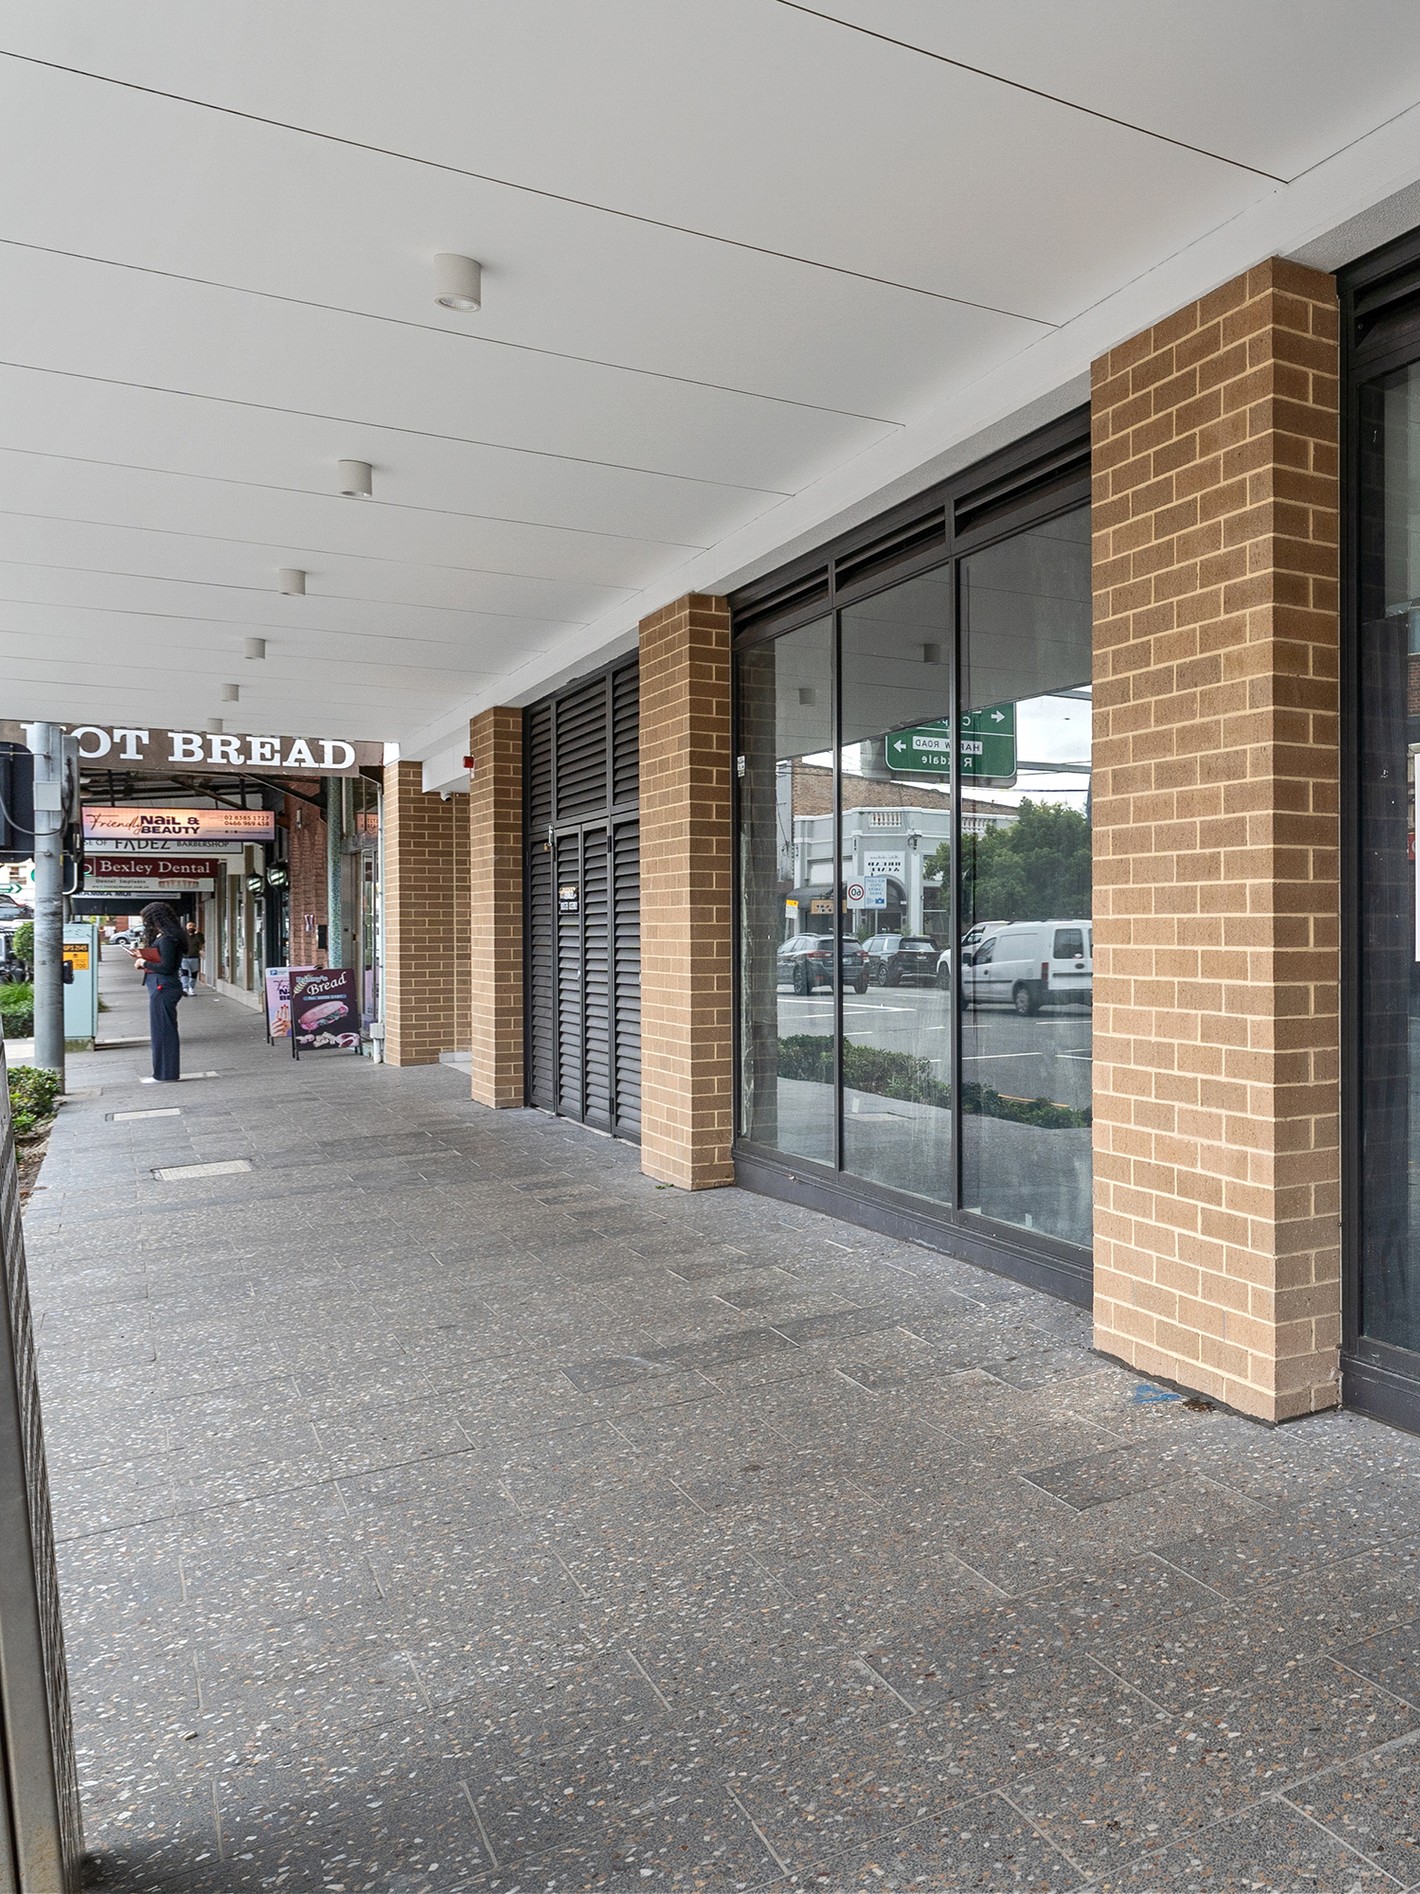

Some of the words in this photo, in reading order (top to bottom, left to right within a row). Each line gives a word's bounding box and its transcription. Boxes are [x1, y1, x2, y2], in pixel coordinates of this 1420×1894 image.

[168, 732, 356, 770] BREAD
[86, 814, 142, 836] Friendly
[188, 816, 200, 826] &
[141, 826, 200, 834] BEAUTY
[100, 860, 152, 874] Bexley
[158, 862, 210, 874] Dental
[306, 972, 348, 995] Bread
